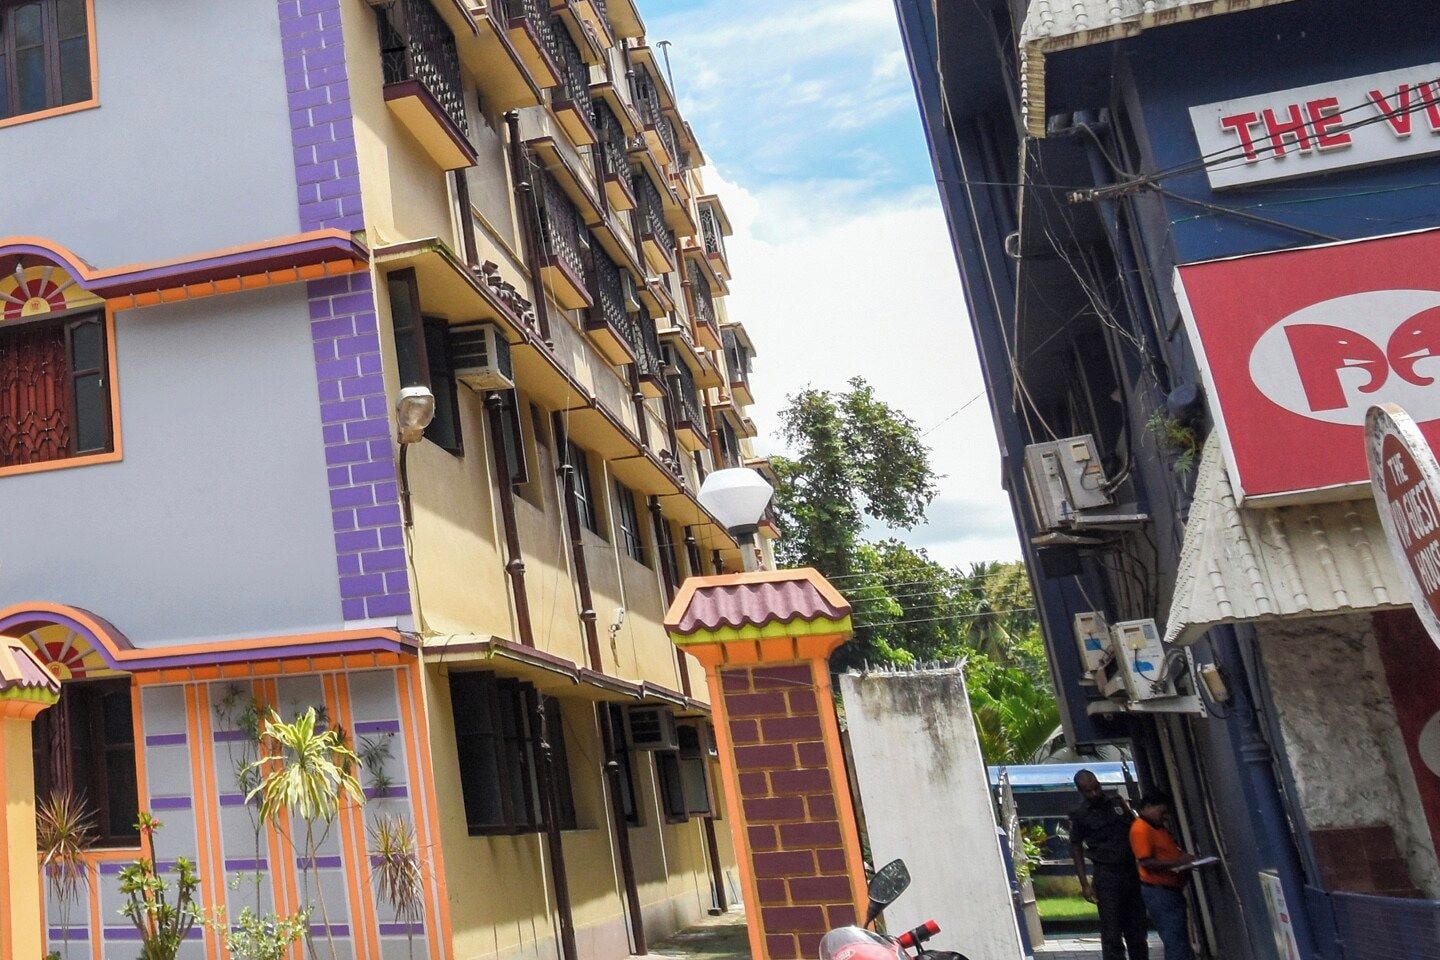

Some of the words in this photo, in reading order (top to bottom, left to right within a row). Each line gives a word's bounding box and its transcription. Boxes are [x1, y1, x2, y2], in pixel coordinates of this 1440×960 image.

[1220, 96, 1352, 162] THE
[1366, 76, 1440, 137] VI
[1387, 452, 1409, 486] THE
[1403, 479, 1439, 540] GUEST
